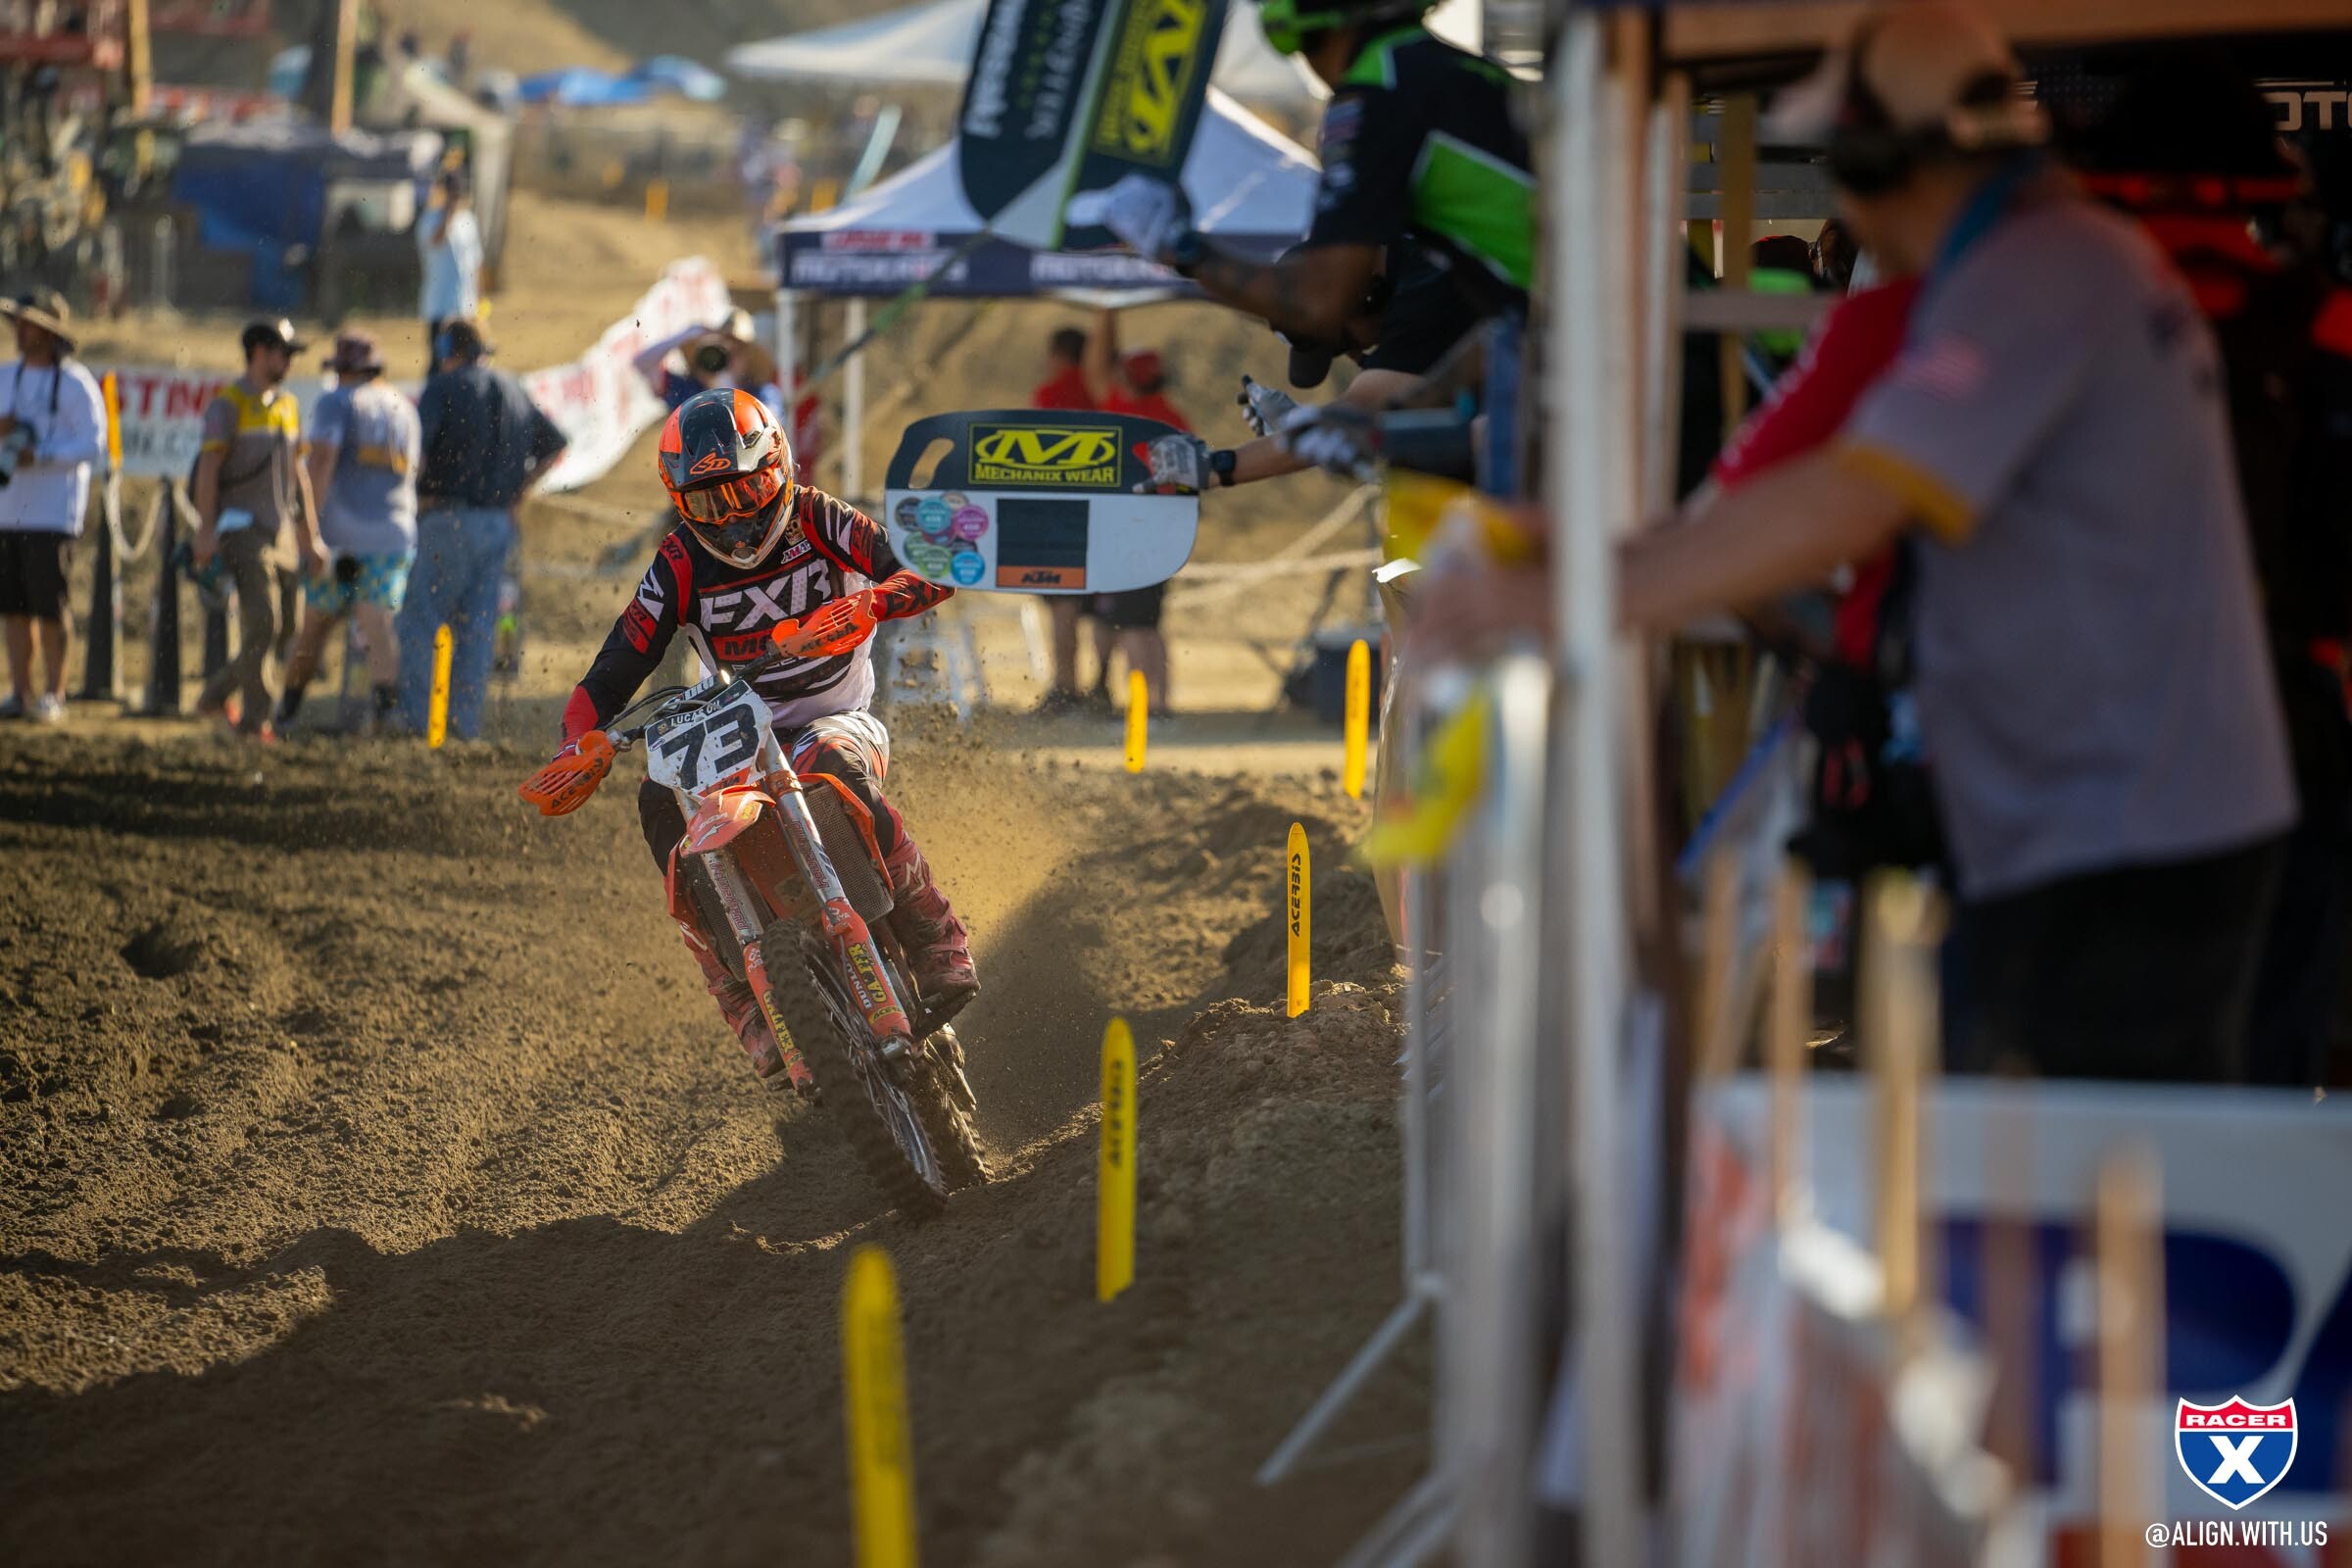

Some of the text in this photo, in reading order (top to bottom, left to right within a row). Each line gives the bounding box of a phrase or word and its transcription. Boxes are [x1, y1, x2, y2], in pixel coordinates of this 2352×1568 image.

[975, 463, 1114, 482] MECHANIX WEAR
[700, 559, 832, 632] FXR
[1020, 570, 1061, 584] KTM
[670, 709, 707, 727] LUCAS
[660, 703, 760, 791] 73
[846, 962, 874, 1010] DUNLO
[848, 943, 888, 1003] GAFER
